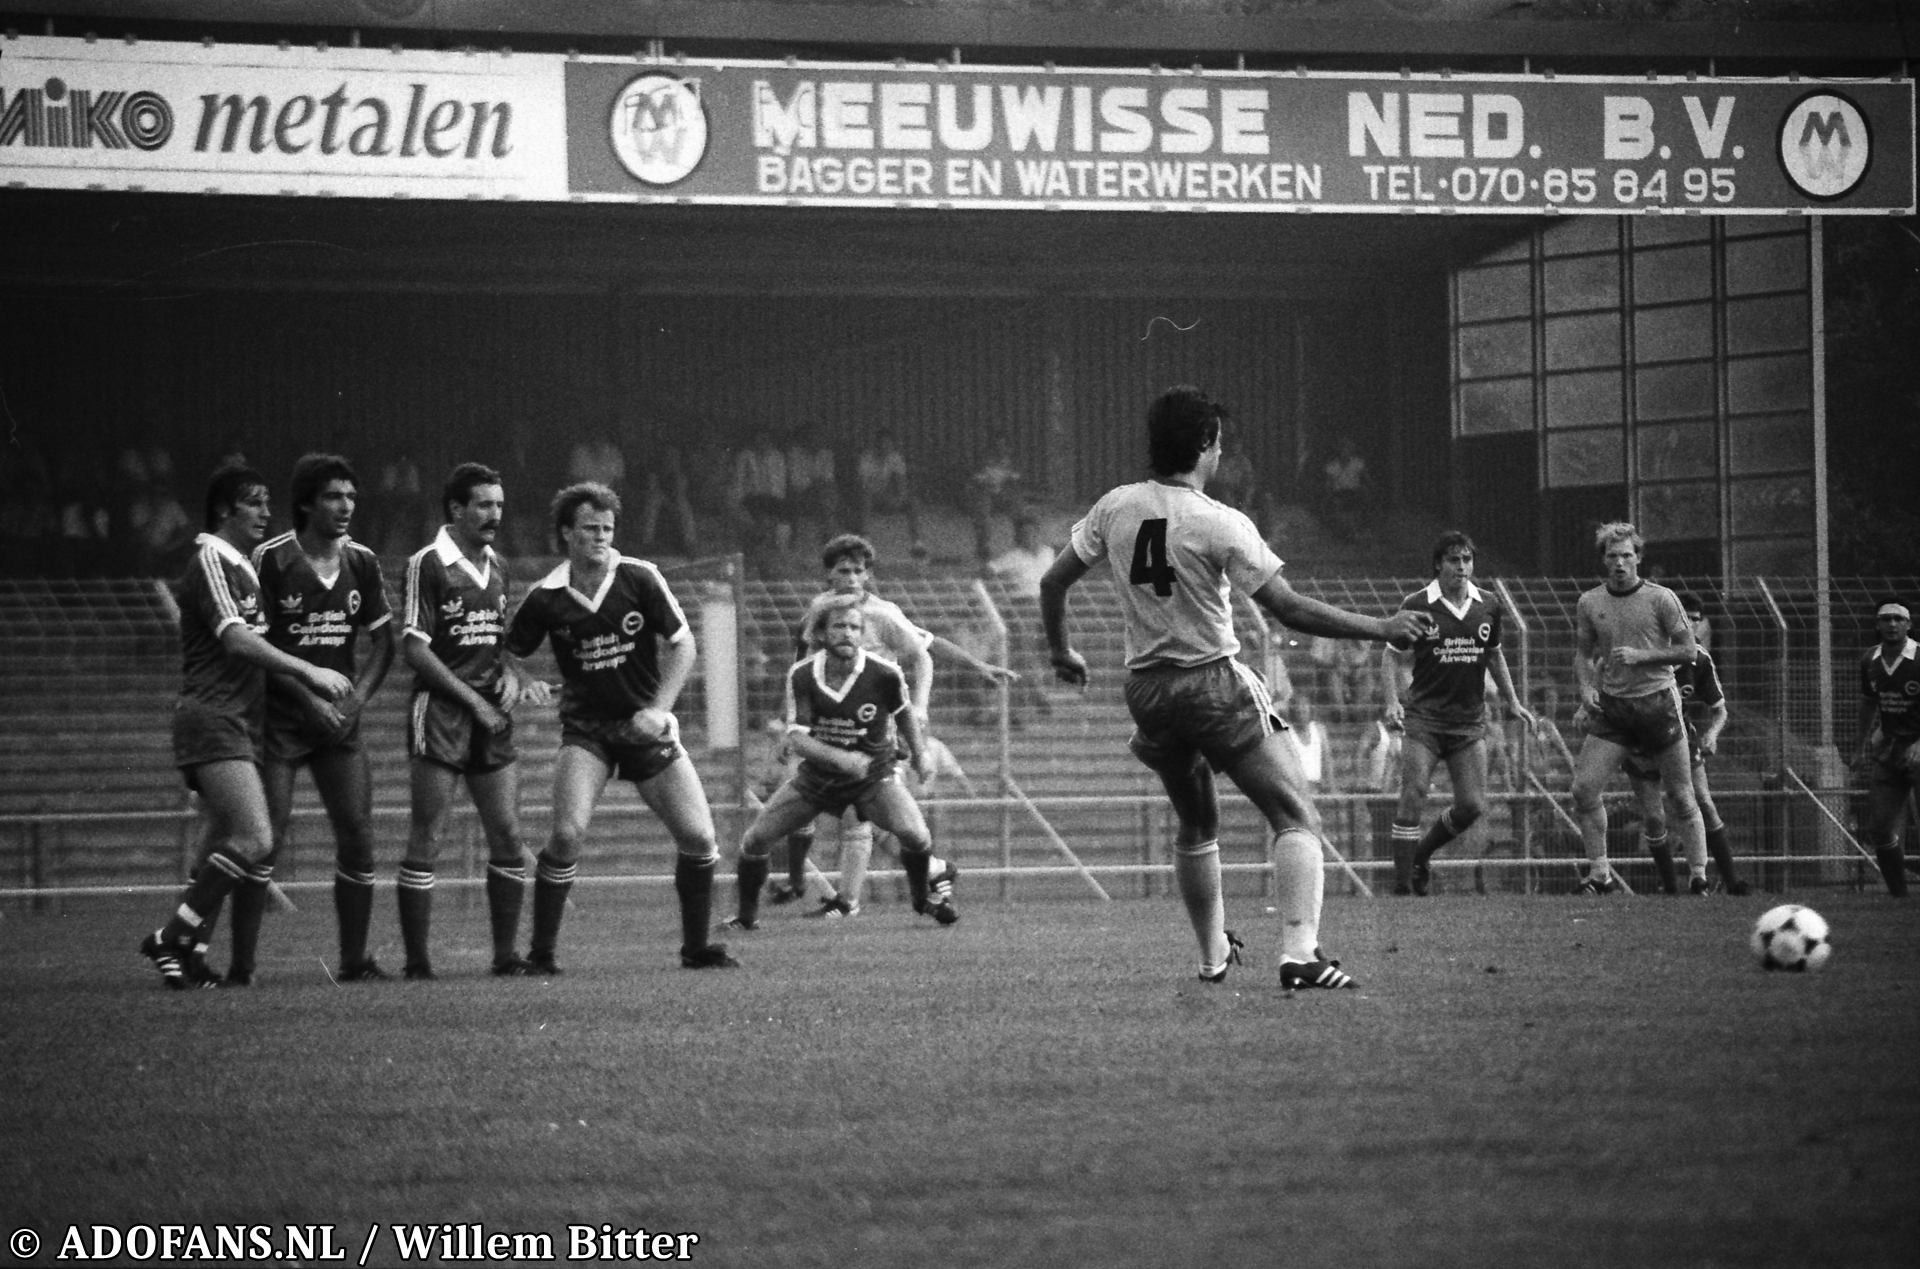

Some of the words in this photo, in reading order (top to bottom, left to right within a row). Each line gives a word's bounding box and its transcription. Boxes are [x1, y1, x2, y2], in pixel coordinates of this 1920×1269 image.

[194, 81, 514, 159] metalen
[752, 79, 1270, 155] MEEUWISSE
[1348, 91, 1543, 160] NED.
[1604, 95, 1745, 160] B.V.
[757, 155, 934, 195] BAGGER
[945, 158, 1001, 196] EN
[1015, 159, 1323, 201] WATERWERKEN
[1613, 168, 1667, 203] 84
[1683, 167, 1736, 203] 95
[1130, 518, 1178, 597] 4
